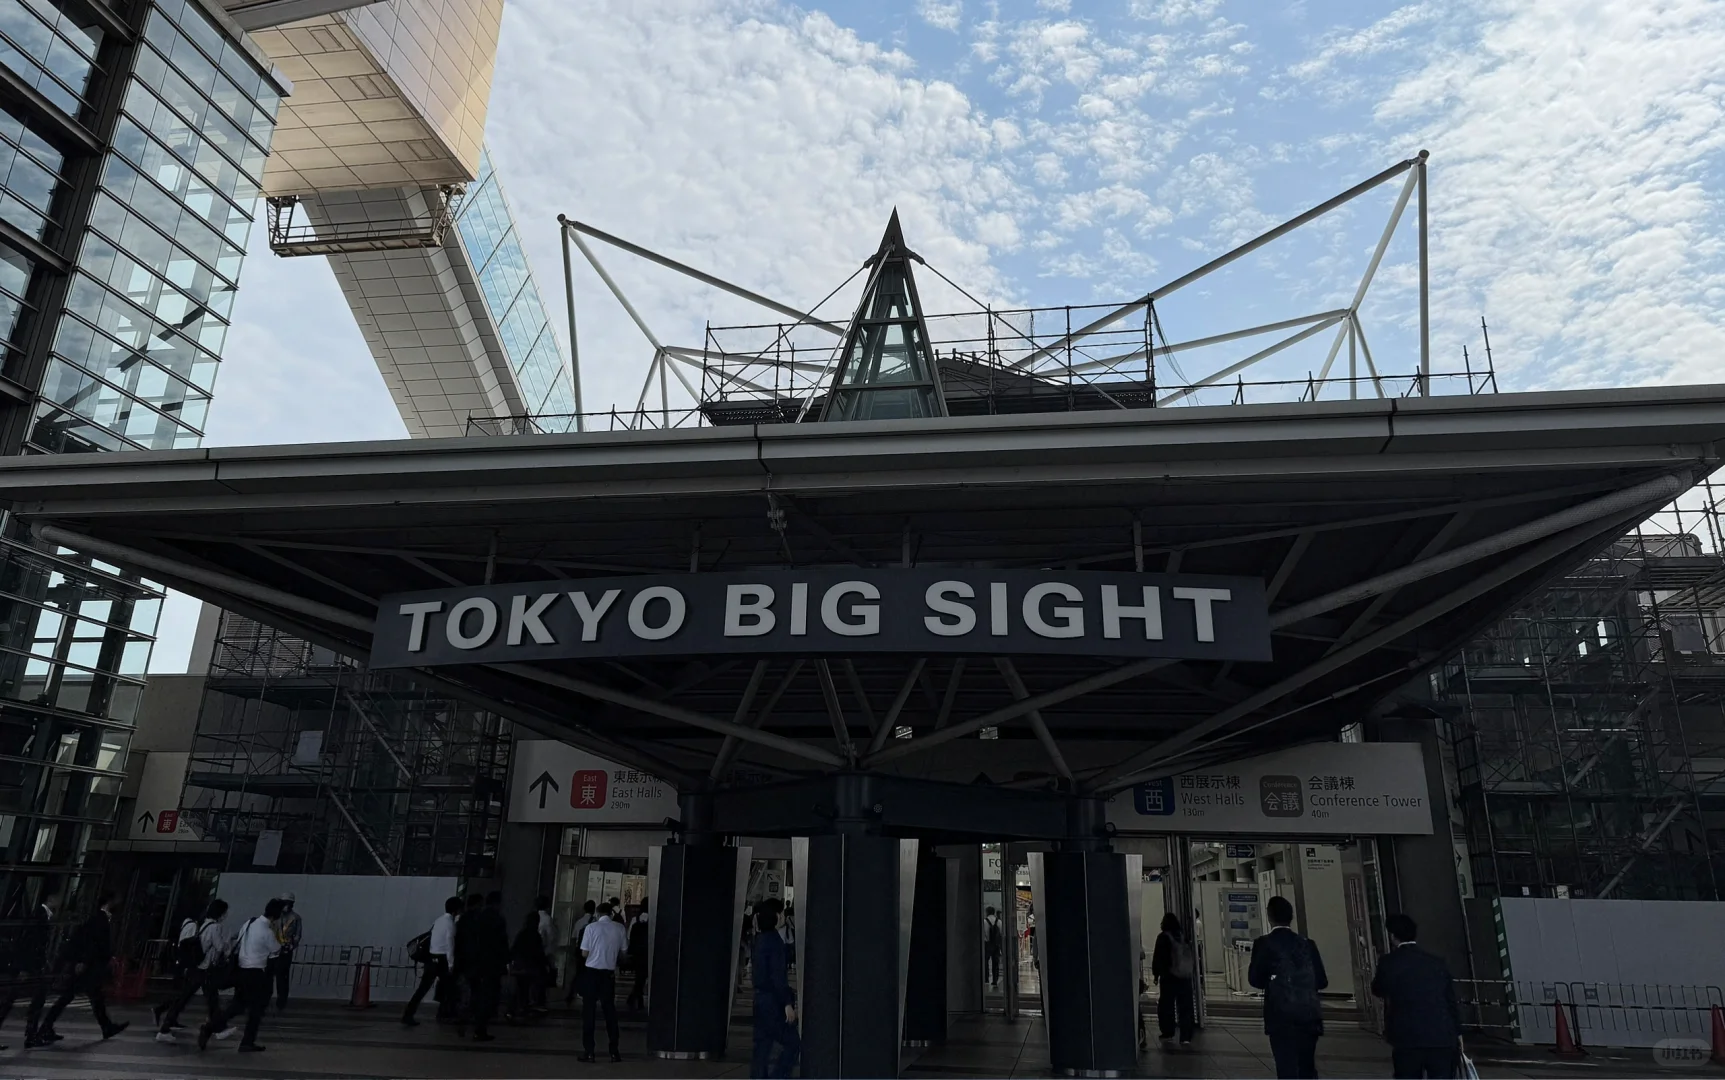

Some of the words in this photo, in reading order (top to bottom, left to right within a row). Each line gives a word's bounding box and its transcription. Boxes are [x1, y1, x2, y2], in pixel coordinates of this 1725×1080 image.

[399, 586, 687, 653] TOKYO
[723, 580, 881, 638] BIG
[923, 580, 1231, 643] SIGHT
[583, 774, 597, 782] East
[1180, 775, 1241, 790] 西展示棟
[1262, 781, 1298, 789] Conference
[1308, 776, 1356, 791] 会議棟
[580, 784, 597, 805] 東
[612, 787, 634, 798] East
[637, 786, 662, 798] Halls
[1180, 792, 1211, 805] West
[1215, 792, 1245, 806] Halls
[610, 801, 631, 810] 290m
[1145, 789, 1164, 812] 西
[1264, 791, 1300, 811] 会議
[1310, 793, 1380, 807] Conference
[1383, 795, 1422, 808] Tower
[1182, 808, 1205, 817] 130m
[1311, 809, 1330, 818] 40m
[162, 818, 173, 831] 東
